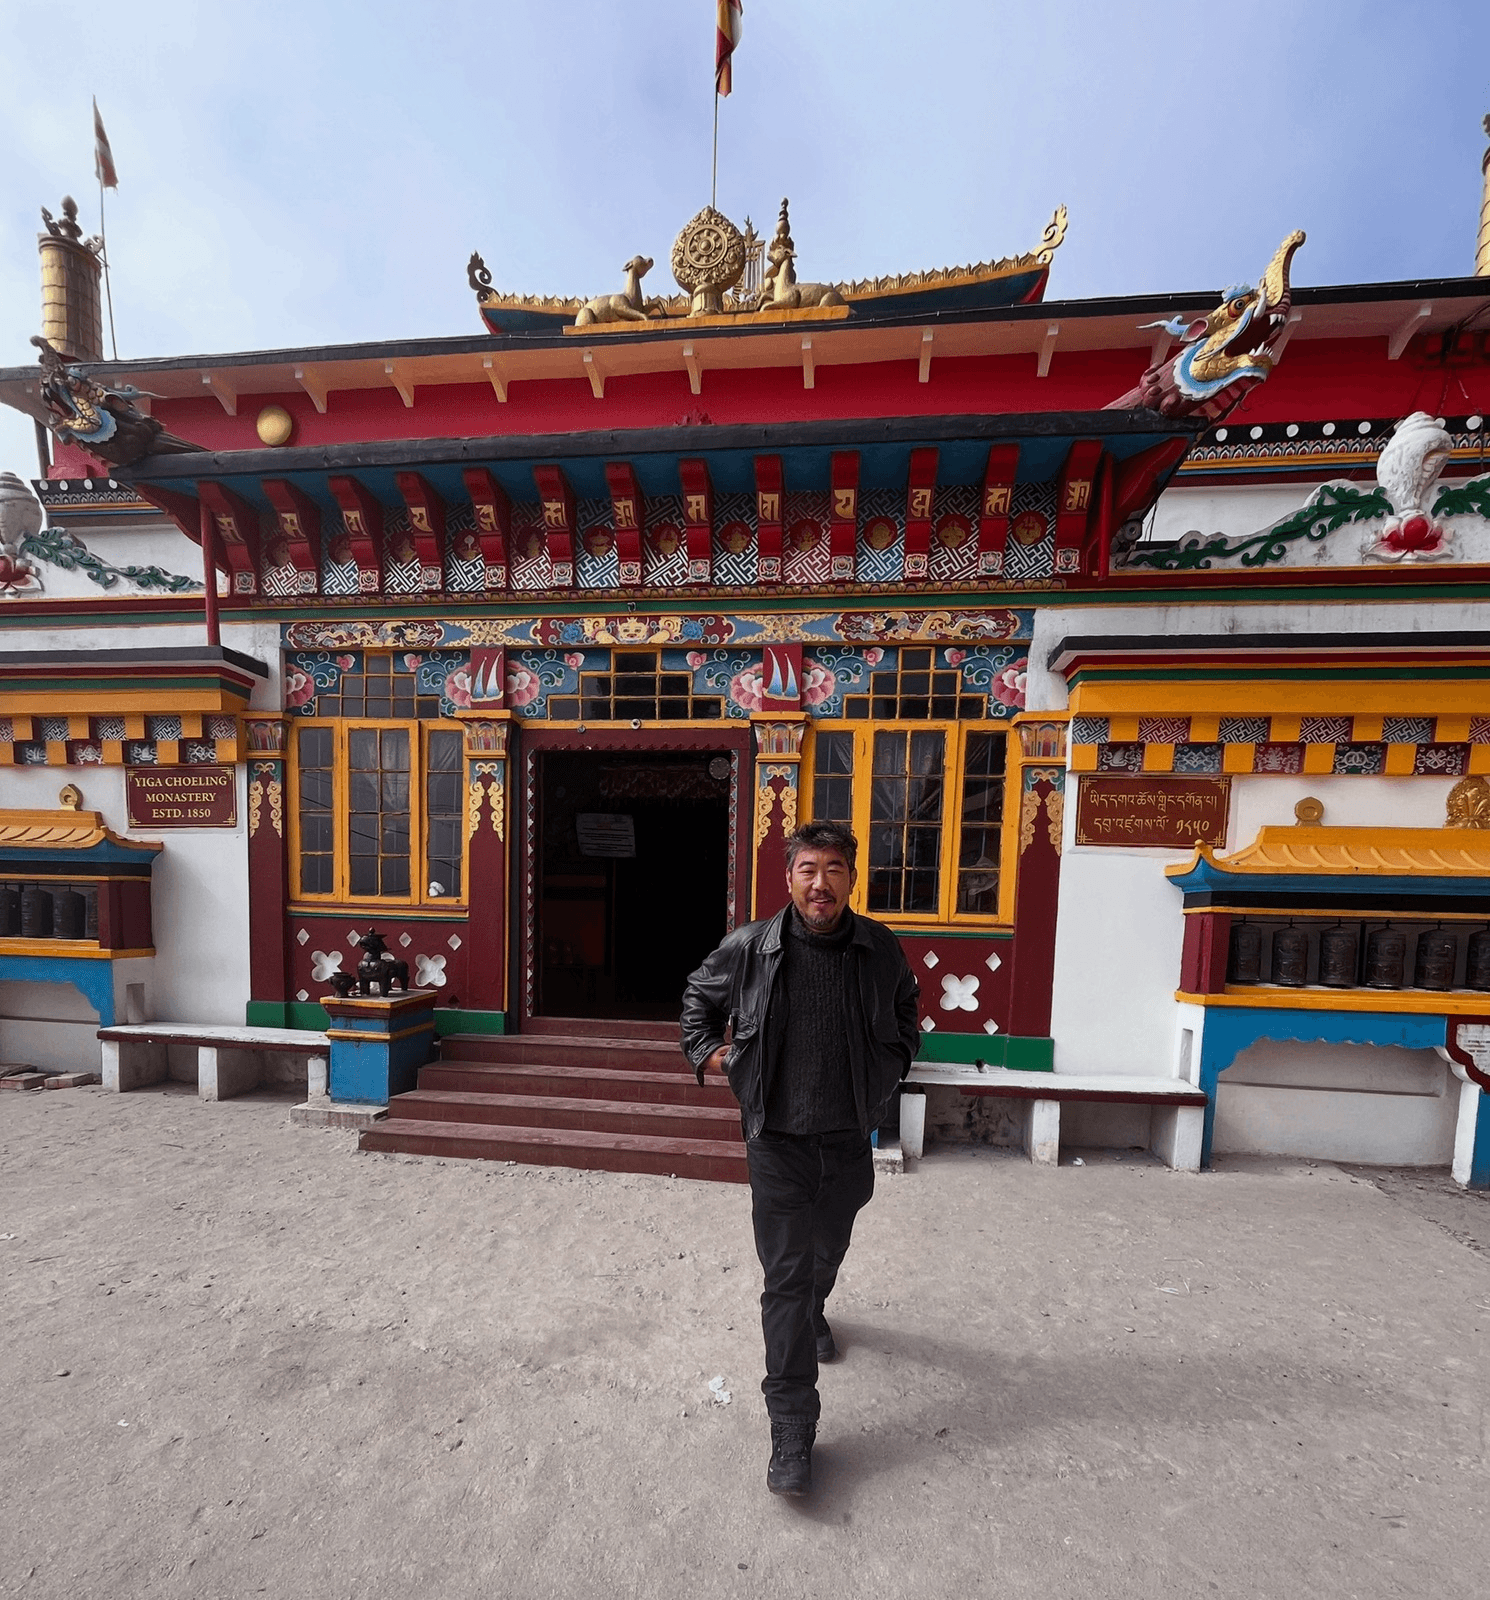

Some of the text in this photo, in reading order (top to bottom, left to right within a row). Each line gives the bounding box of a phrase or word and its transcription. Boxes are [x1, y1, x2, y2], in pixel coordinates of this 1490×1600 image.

[134, 776, 228, 788] YIGA CHOELING
[145, 792, 217, 803] MONASTERY
[152, 808, 211, 818] ESTD. 1850
